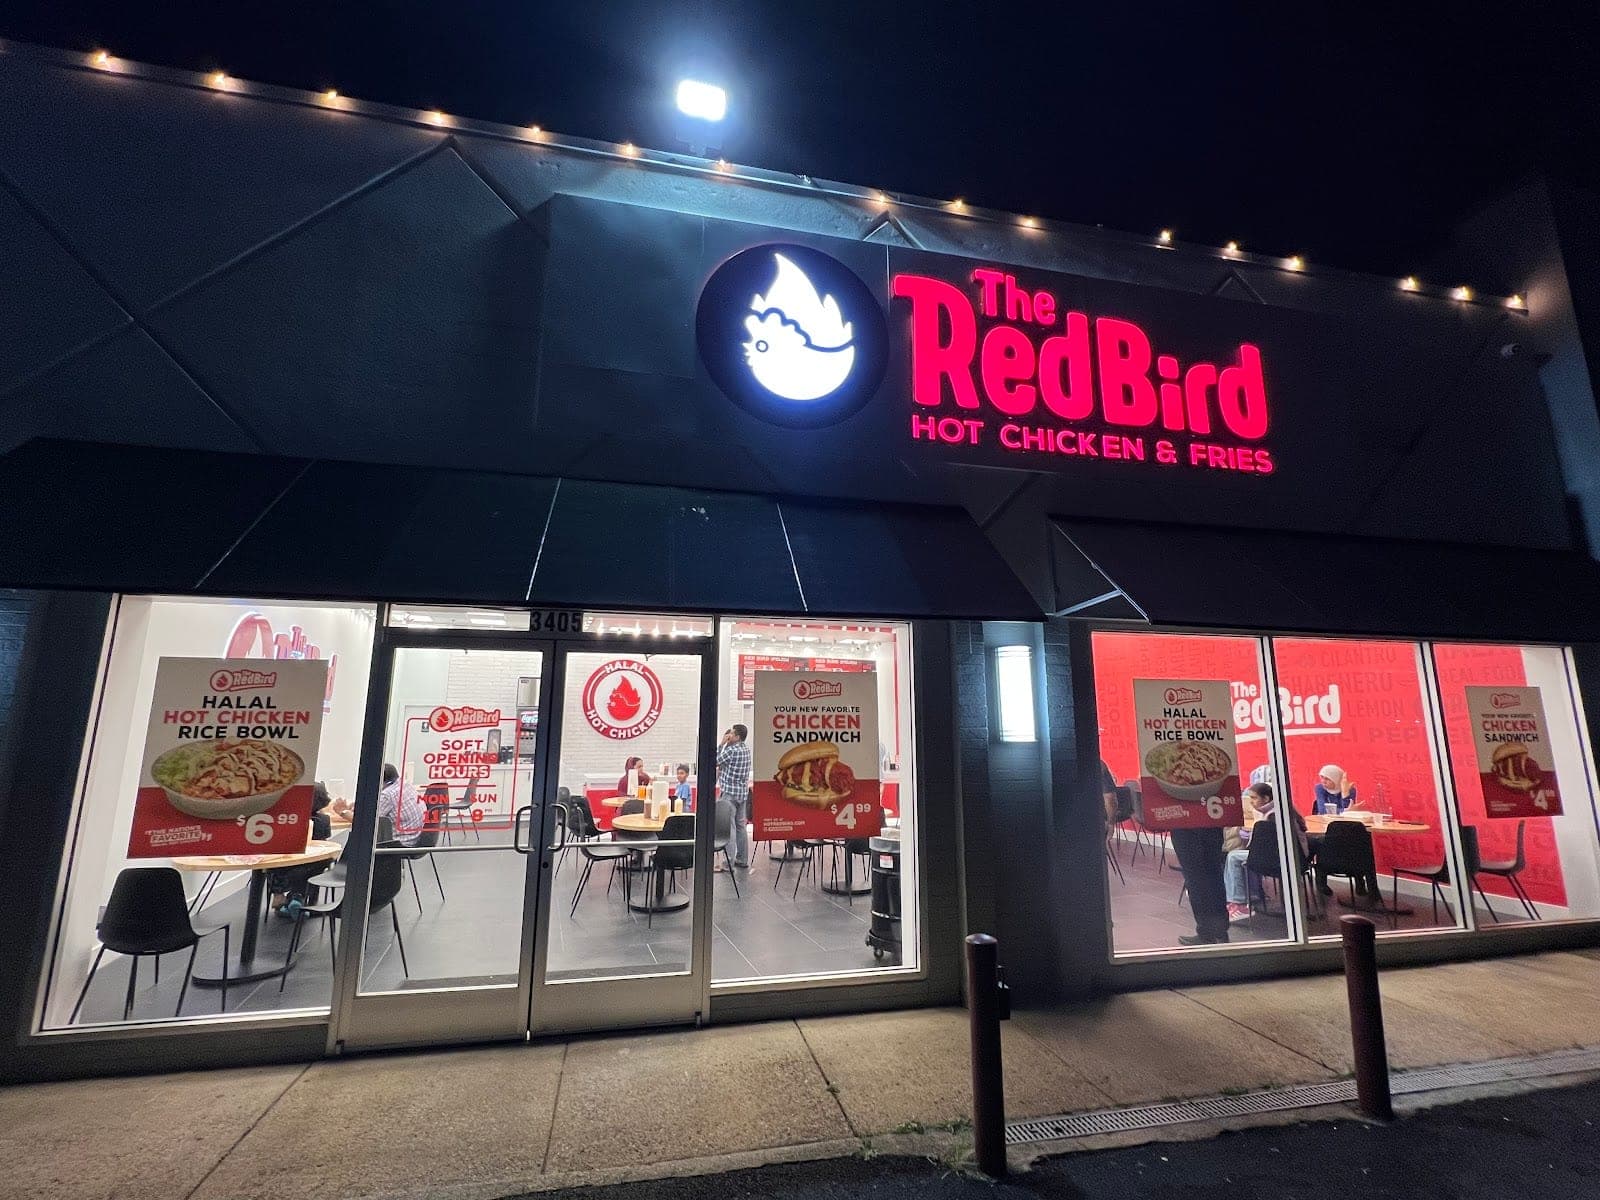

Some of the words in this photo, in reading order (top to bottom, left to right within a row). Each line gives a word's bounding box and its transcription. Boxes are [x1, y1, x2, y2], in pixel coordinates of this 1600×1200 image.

[972, 269, 1056, 325] The
[893, 274, 1269, 440] RedBird
[911, 414, 984, 444] HOT
[1000, 424, 1145, 461] CHICKEN
[1156, 440, 1177, 464] &
[1190, 443, 1274, 474] FRIES
[531, 612, 581, 632] 3405
[604, 661, 645, 675] HALAL
[1230, 682, 1257, 698] The
[202, 696, 277, 709] HALAL
[1233, 684, 1341, 730] edBird
[163, 711, 209, 724] HOT
[217, 711, 310, 724] CHICKEN
[454, 710, 499, 725] RedBird
[1163, 708, 1207, 718] HALAL
[587, 709, 608, 733] HOT
[609, 709, 659, 739] CHICKEN
[772, 714, 861, 729] CHICKEN
[1144, 720, 1169, 729] HOT
[1175, 720, 1227, 729] CHICKEN
[1482, 721, 1537, 732] CHICKEN
[178, 726, 228, 739] RICE
[236, 726, 299, 739] BOWL
[773, 731, 861, 743] SANDWICH
[1154, 731, 1182, 741] RICE
[1187, 731, 1224, 741] BOWL
[1484, 733, 1539, 743] SANDWICH
[441, 740, 484, 751] SOFT
[424, 753, 498, 764] OPENING
[430, 766, 490, 778] HOURS
[417, 794, 449, 804] MON
[469, 793, 497, 804] SUN
